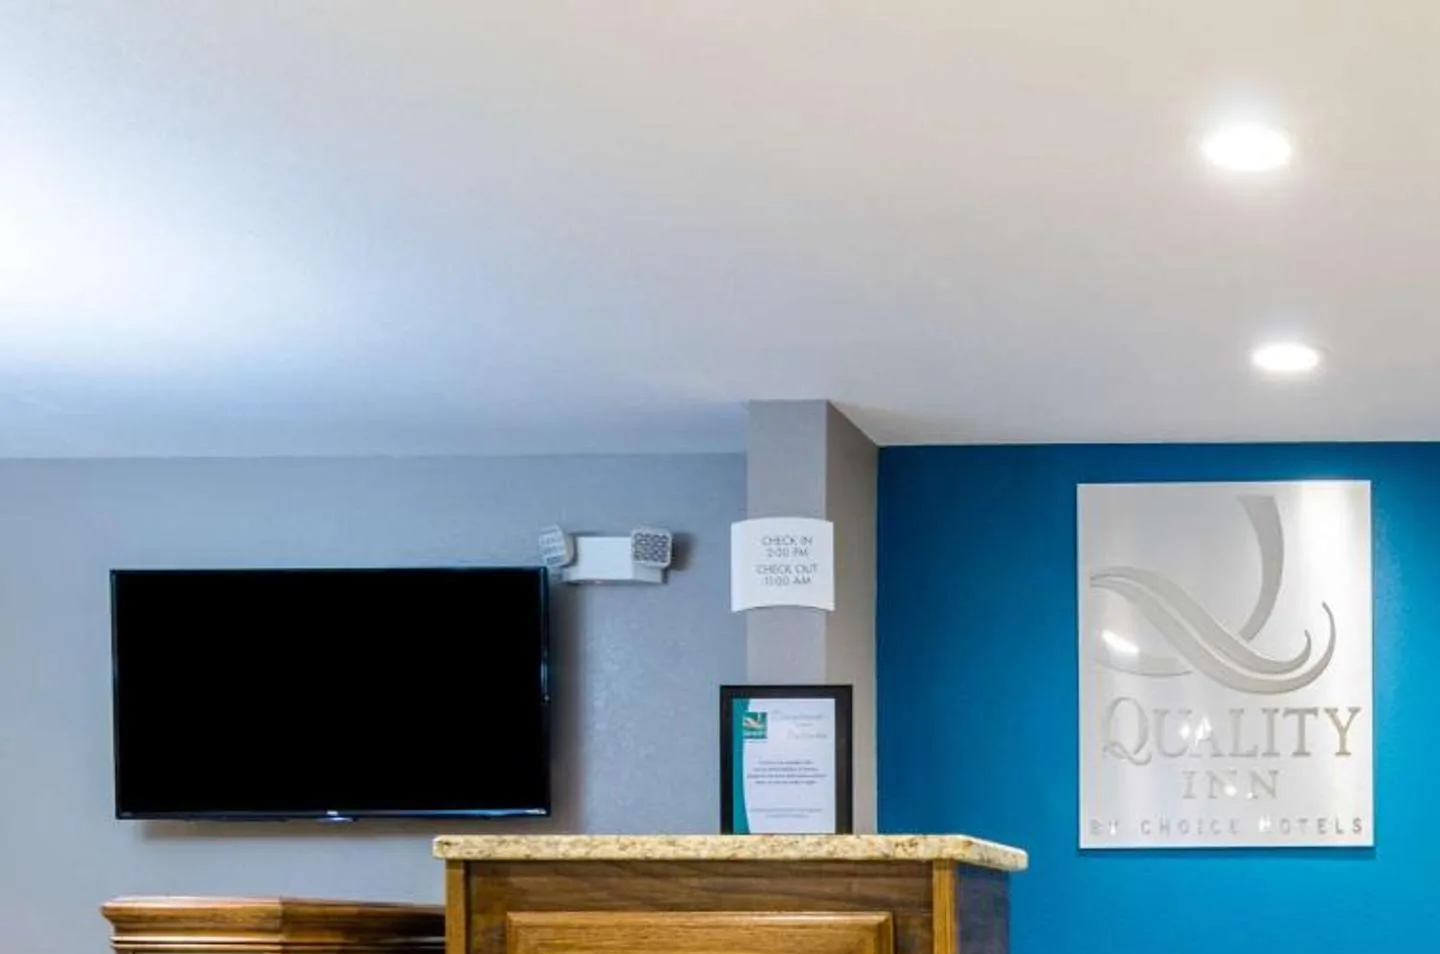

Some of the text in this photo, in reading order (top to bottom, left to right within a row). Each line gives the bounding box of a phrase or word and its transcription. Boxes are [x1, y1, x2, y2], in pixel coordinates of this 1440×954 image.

[755, 563, 818, 575] CHECK OUT
[1102, 697, 1361, 766] QUALITY
[1181, 770, 1279, 800] INN
[1140, 818, 1242, 836] CHOICE
[1257, 815, 1363, 835] HOTELS
